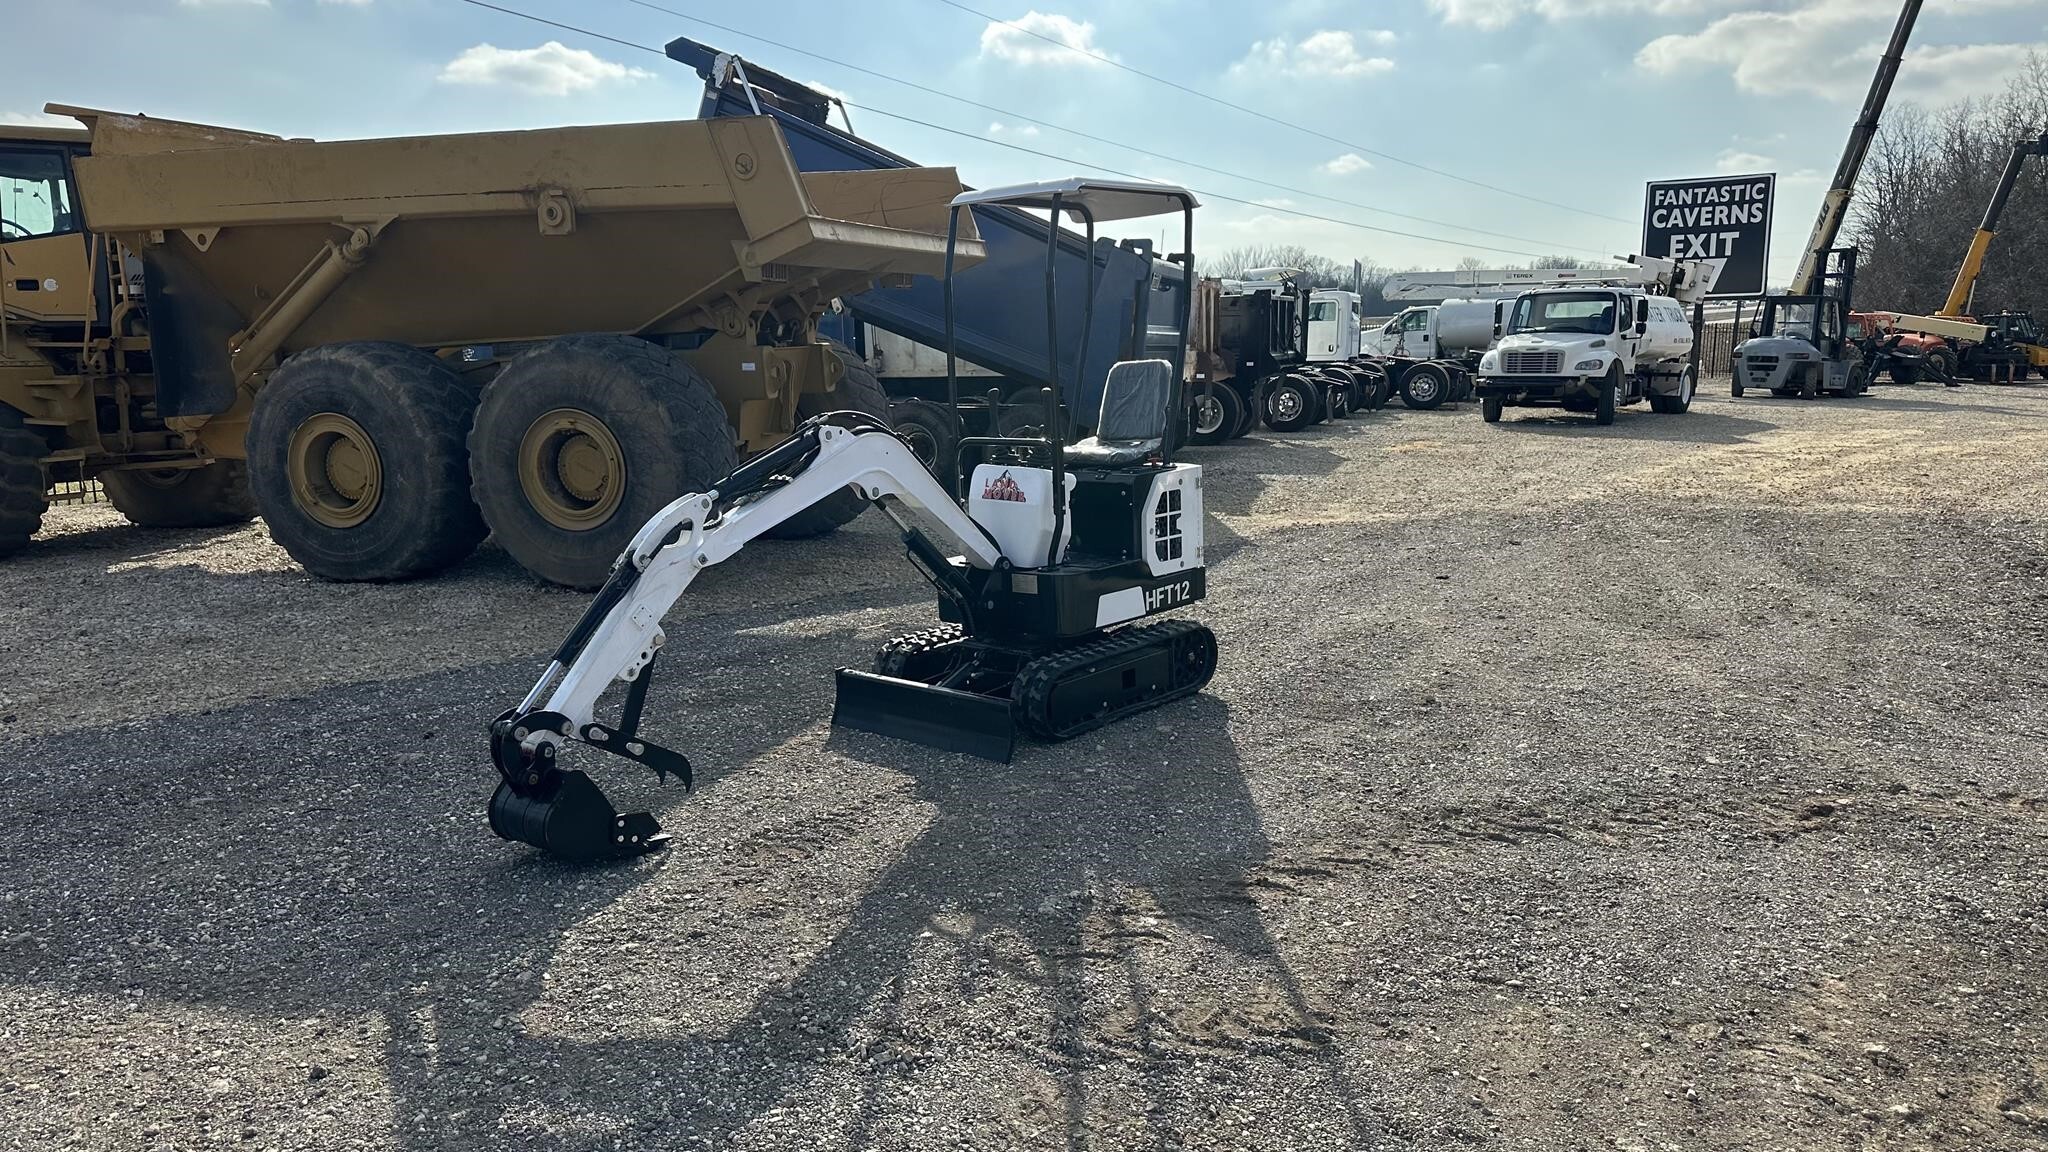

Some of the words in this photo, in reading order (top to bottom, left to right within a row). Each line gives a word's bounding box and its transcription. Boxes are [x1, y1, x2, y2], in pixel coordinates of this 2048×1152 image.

[1654, 183, 1766, 206] FANTASTIC
[1652, 203, 1763, 229] CAVERNS
[1669, 231, 1740, 259] EXIT
[1145, 580, 1190, 611] HFT12
